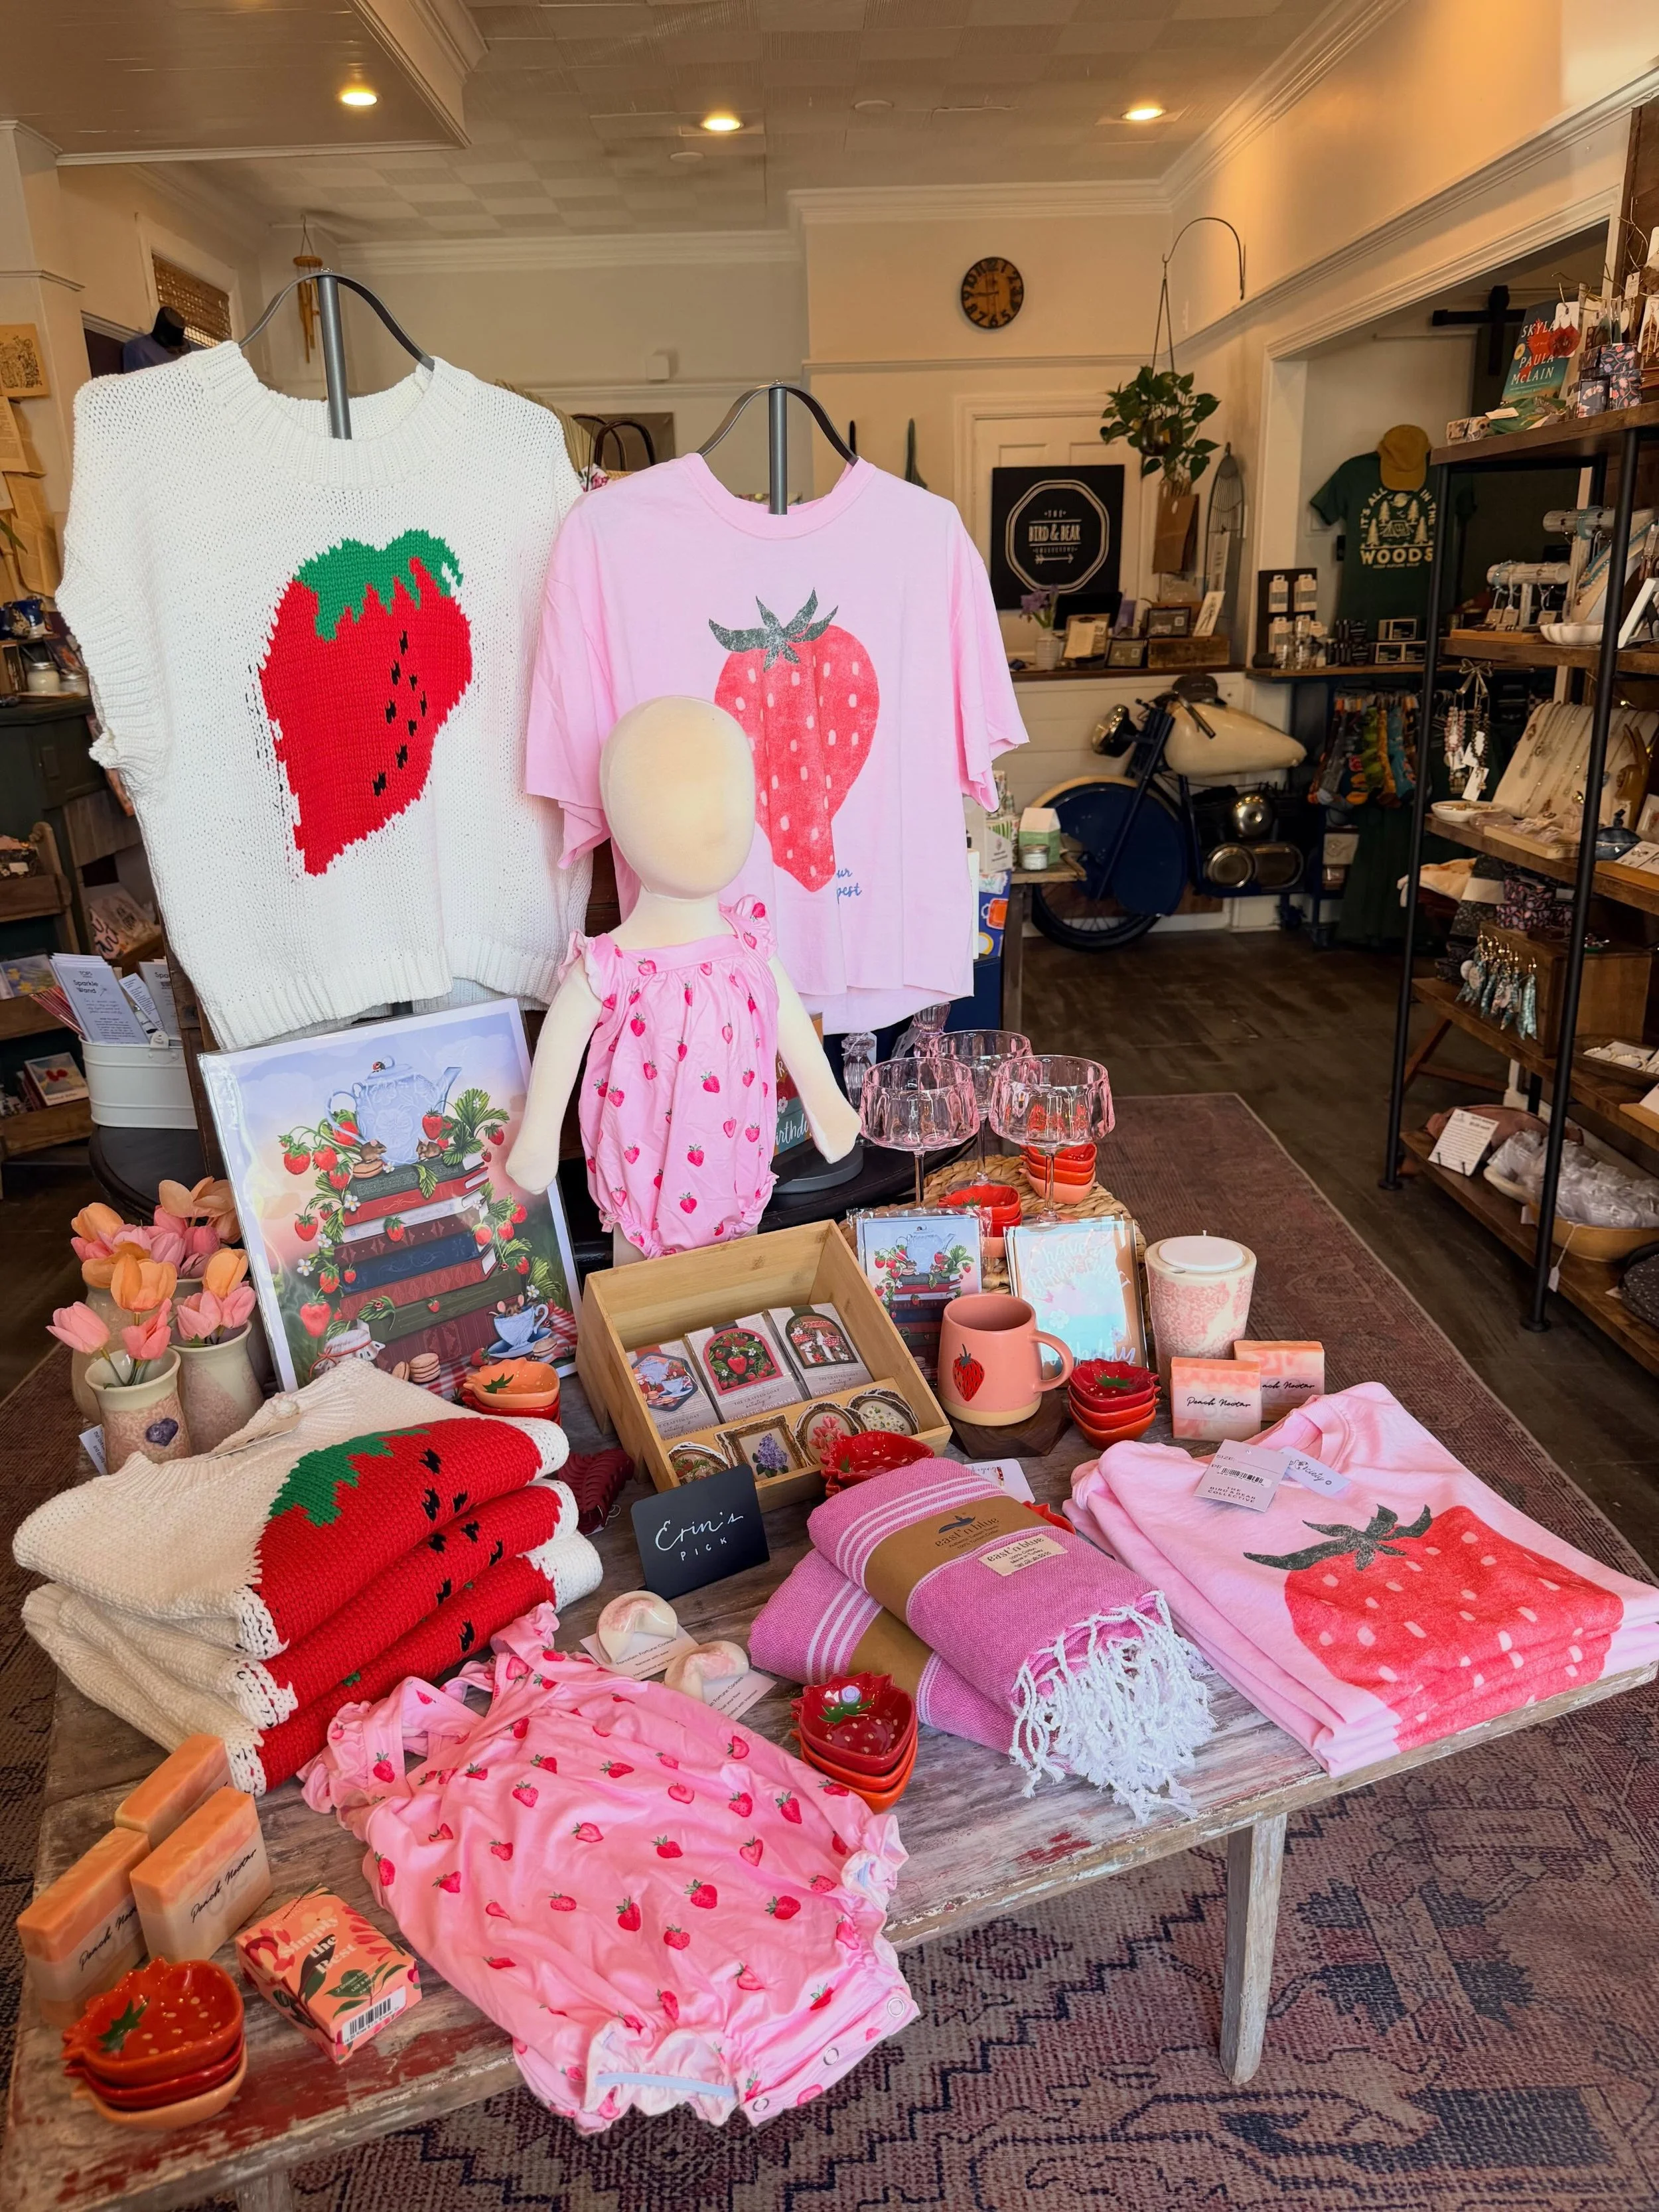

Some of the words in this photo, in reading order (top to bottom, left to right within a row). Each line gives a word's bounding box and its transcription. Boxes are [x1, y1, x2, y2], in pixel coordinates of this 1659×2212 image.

[1521, 320, 1555, 338] SKYLA
[1519, 352, 1553, 368] PAULA
[1511, 367, 1554, 385] McLAIN
[1368, 487, 1388, 506] ALL
[1419, 489, 1433, 502] IN
[1029, 525, 1049, 542] BIRD
[1050, 524, 1059, 542] &
[1060, 524, 1080, 542] BEAR
[1360, 548, 1433, 565] WOODS
[775, 1113, 809, 1145] irthd
[1028, 1258, 1078, 1295] BERRY
[1262, 1380, 1280, 1389] ach
[1283, 1380, 1315, 1389] Nectar
[729, 1408, 761, 1421] MAGNETIC
[762, 1396, 796, 1411] BOOKMARK
[744, 1393, 766, 1403] CRAFTED
[1187, 1396, 1216, 1407] Peach
[1218, 1398, 1251, 1408] Nectar
[1208, 1490, 1255, 1503] COLLECTIVE
[656, 1512, 743, 1551] Erin's
[935, 1526, 972, 1548] east'n
[974, 1517, 1000, 1530] blue
[680, 1537, 727, 1561] PICK
[987, 1545, 1019, 1562] east'n
[1018, 1537, 1045, 1549] blue
[639, 1647, 658, 1656] Fortune
[713, 1689, 729, 1702] Fortune
[728, 1676, 743, 1690] Cookies
[191, 1880, 222, 1923] Peach
[224, 1848, 257, 1885] Nectar
[79, 1926, 112, 1971] Peach
[115, 1907, 137, 1931] Nect
[279, 1915, 339, 1957] Simply
[309, 1935, 338, 1958] the
